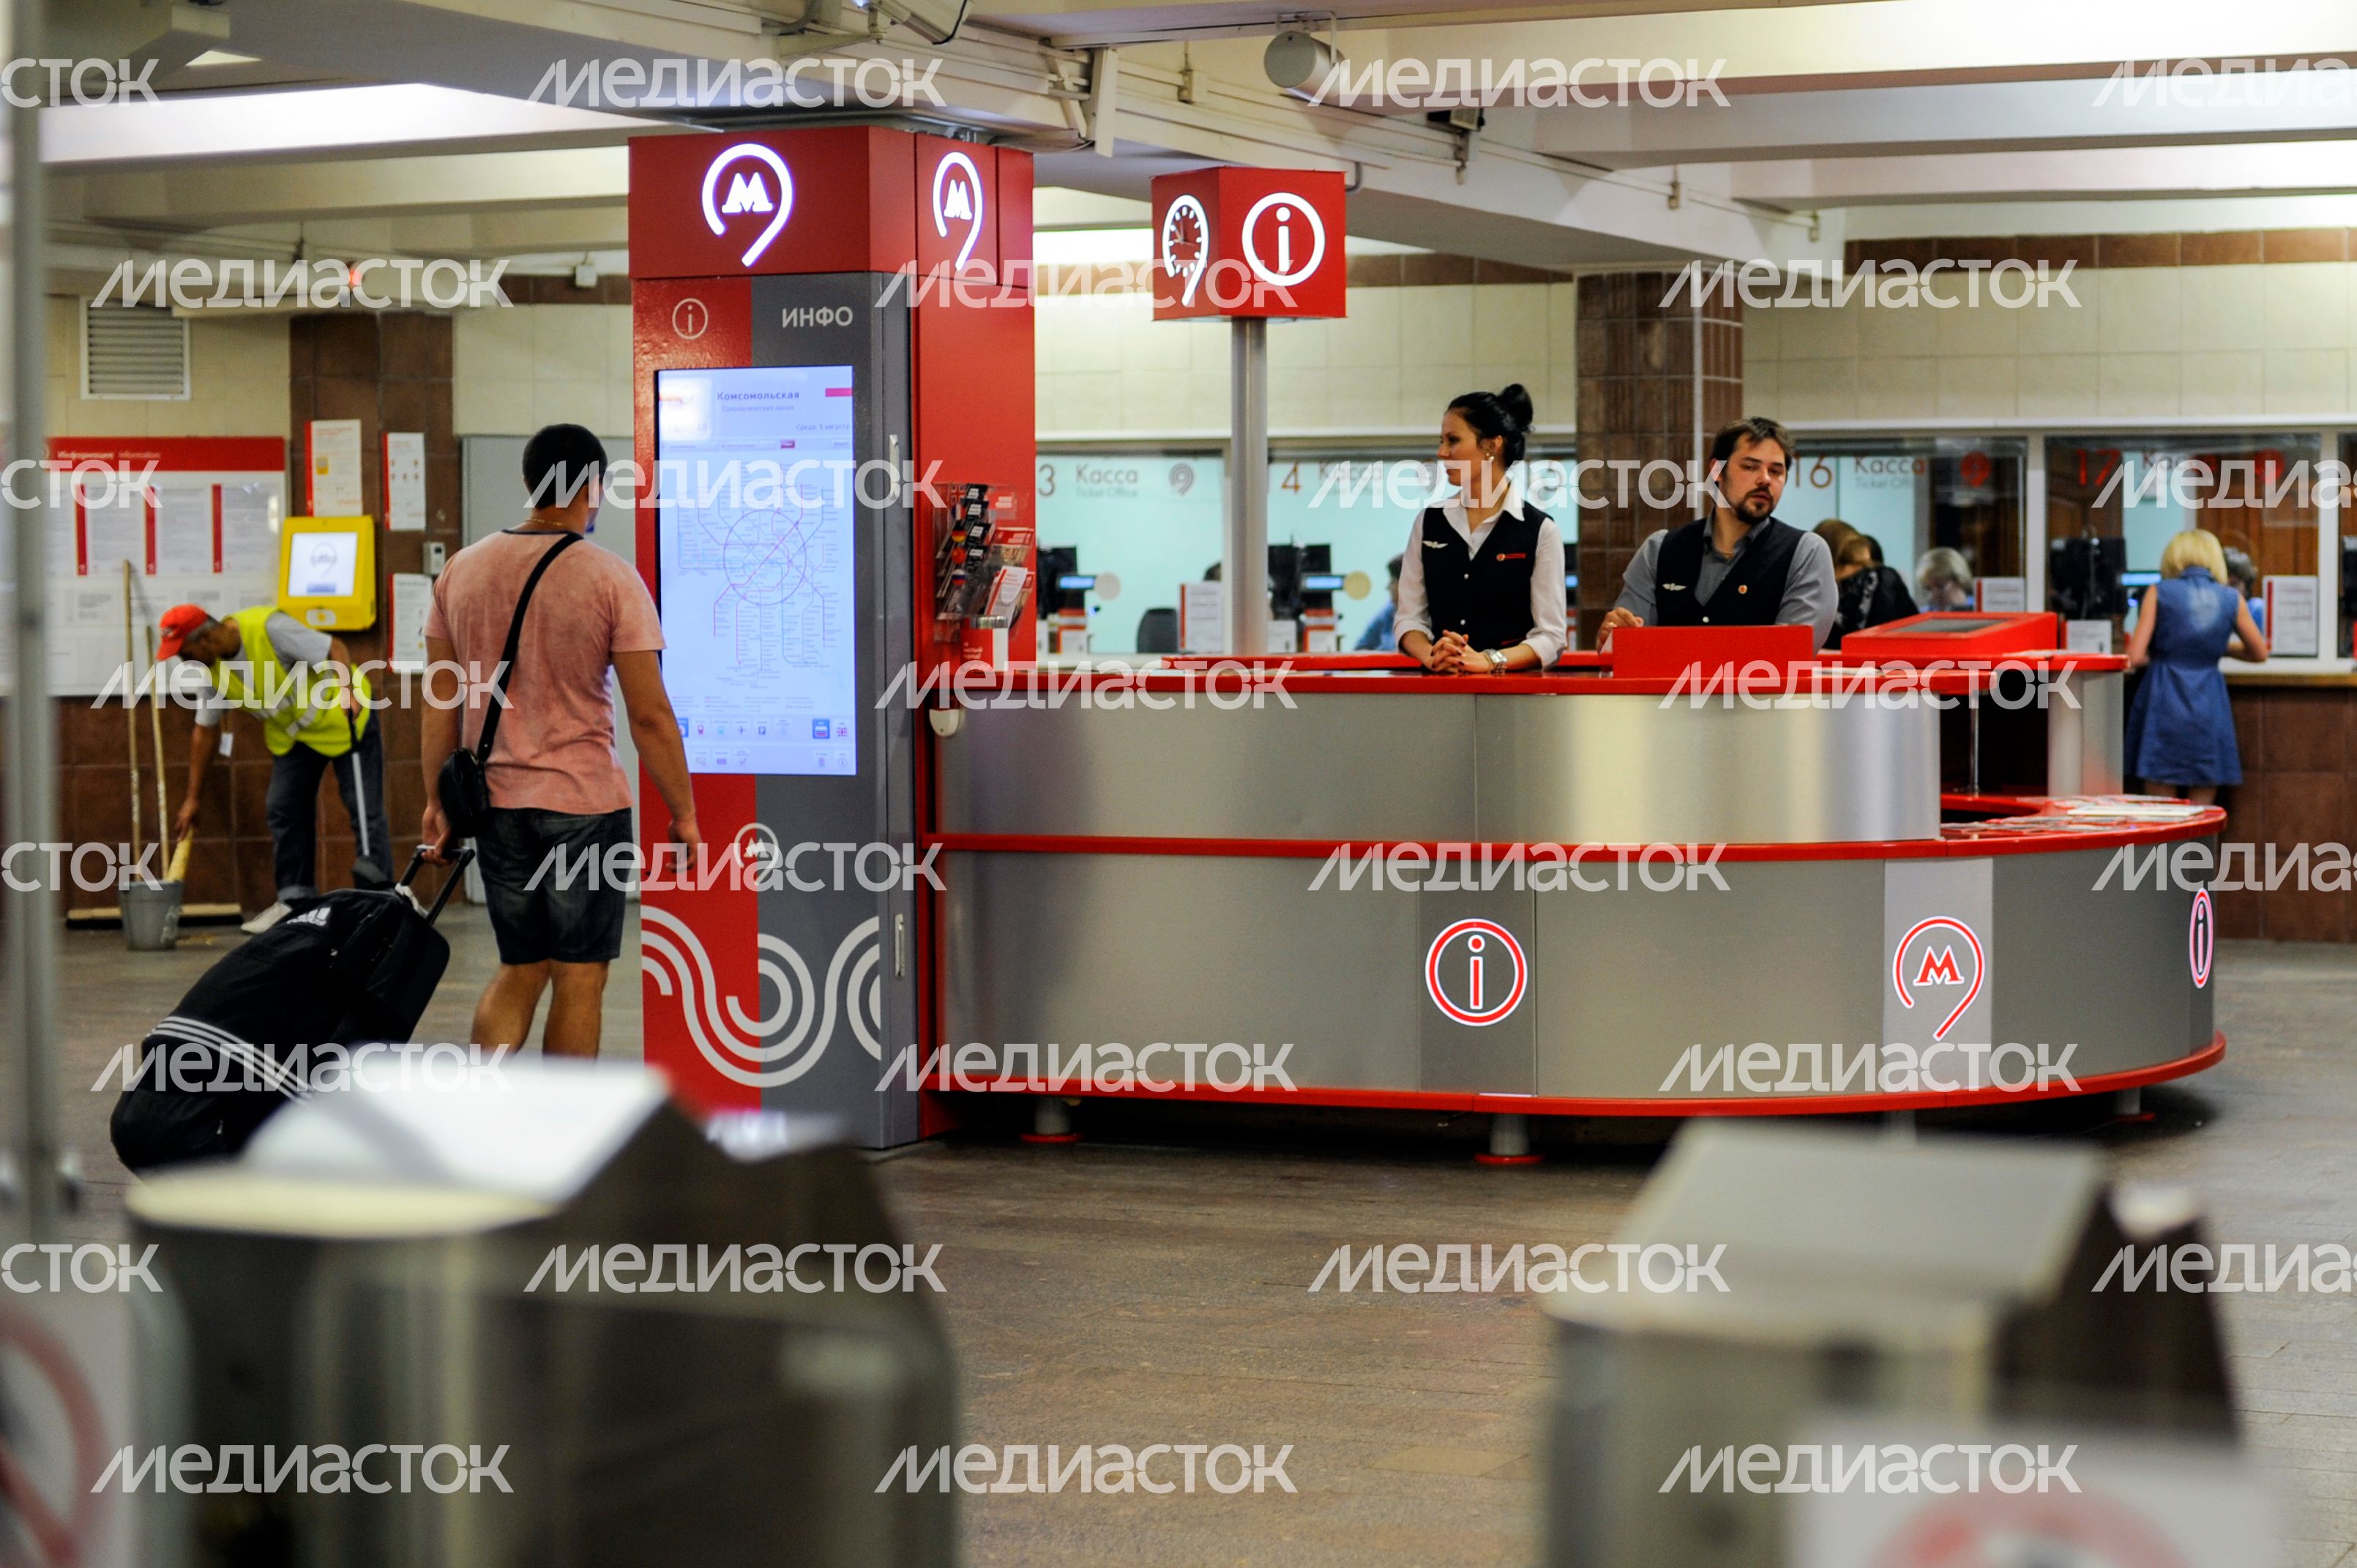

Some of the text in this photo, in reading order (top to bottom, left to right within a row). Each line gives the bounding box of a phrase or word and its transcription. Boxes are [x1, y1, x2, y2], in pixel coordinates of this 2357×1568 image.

[782, 305, 853, 329] ИНФО
[717, 391, 799, 401] Комсомольская
[1076, 463, 1138, 484] Касса
[1792, 452, 1832, 488] 16
[1854, 453, 1927, 474] Касса
[2076, 449, 2121, 486] 17
